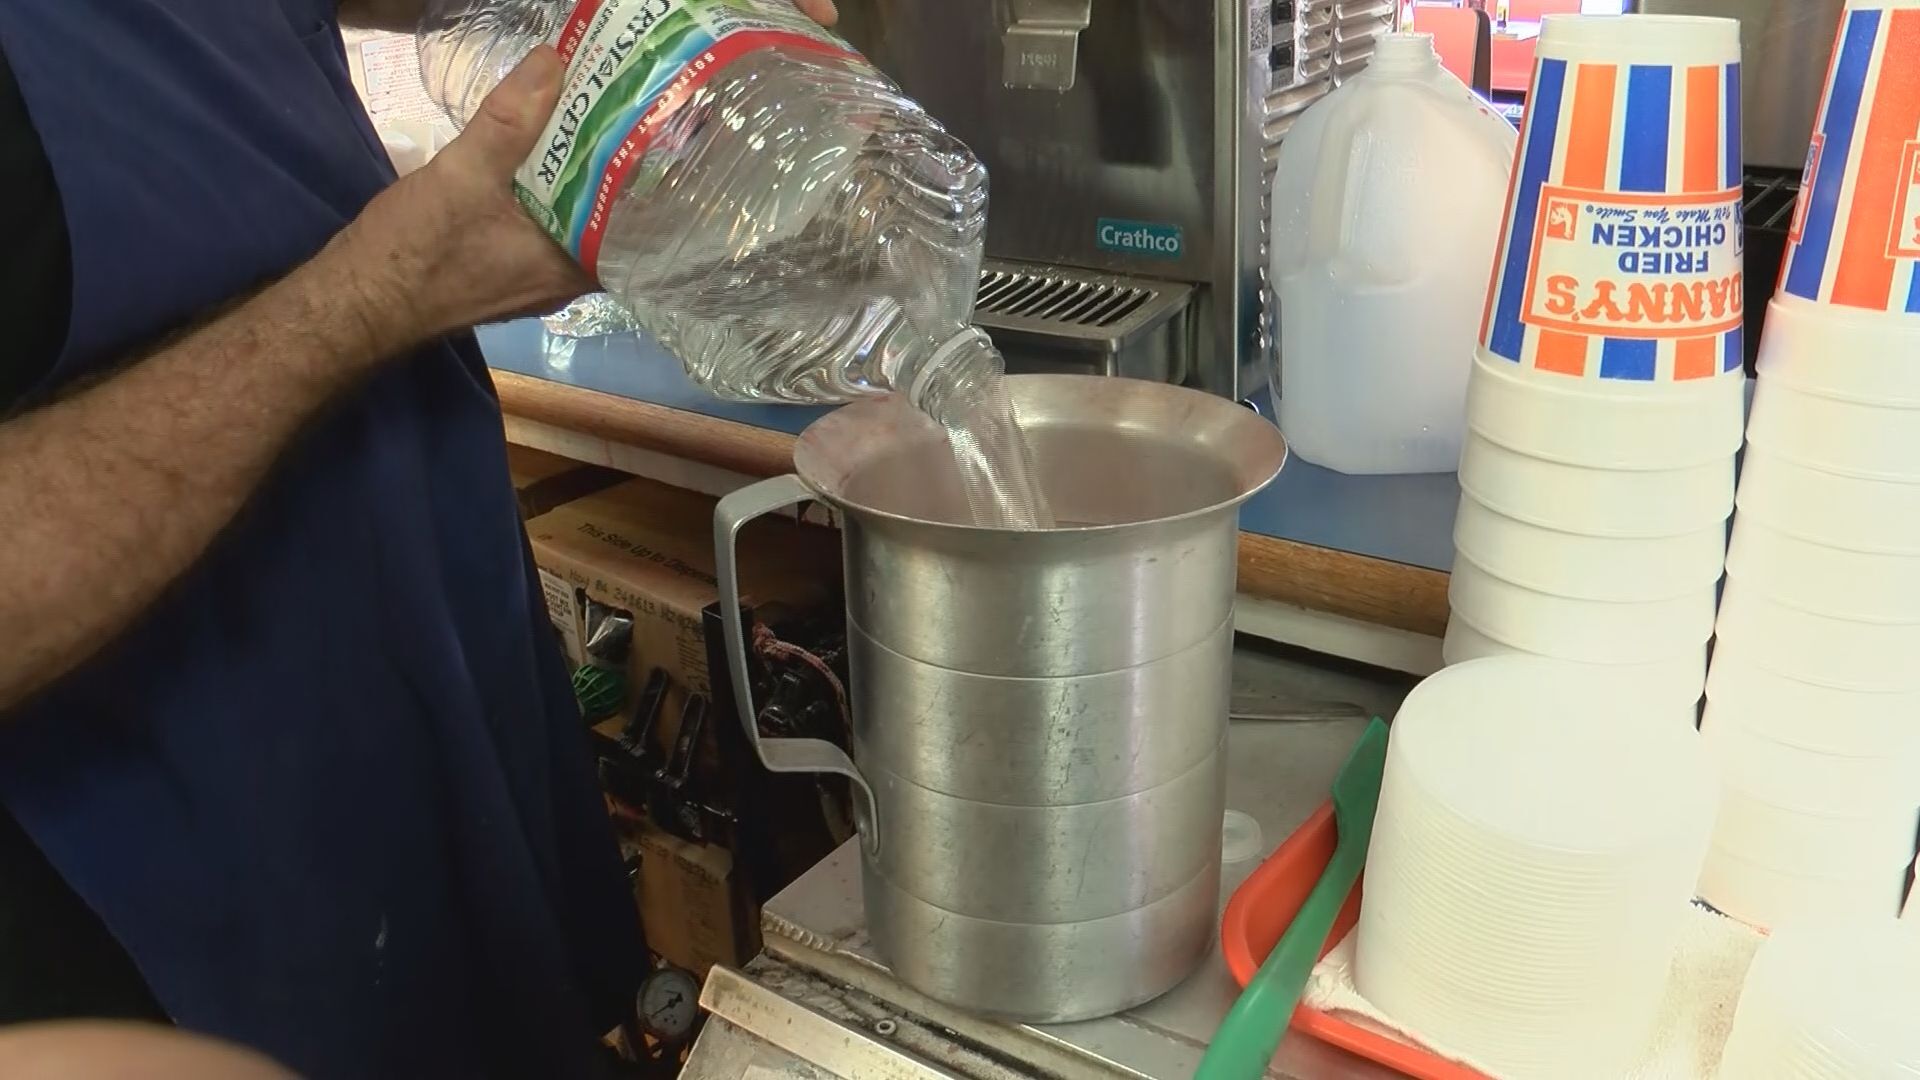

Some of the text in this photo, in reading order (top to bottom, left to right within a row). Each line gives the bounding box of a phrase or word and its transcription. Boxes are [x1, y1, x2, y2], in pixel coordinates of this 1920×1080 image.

[586, 0, 671, 90] CRYSTAL
[538, 92, 589, 185] GEYSER
[612, 140, 635, 168] THE
[1643, 206, 1671, 223] You
[1676, 206, 1711, 223] Make
[1101, 225, 1179, 253] Crathco
[1592, 223, 1726, 248] CHICKEN
[1618, 251, 1709, 274] FRIED
[1544, 271, 1742, 323] DANNY'S
[601, 533, 632, 551] Side
